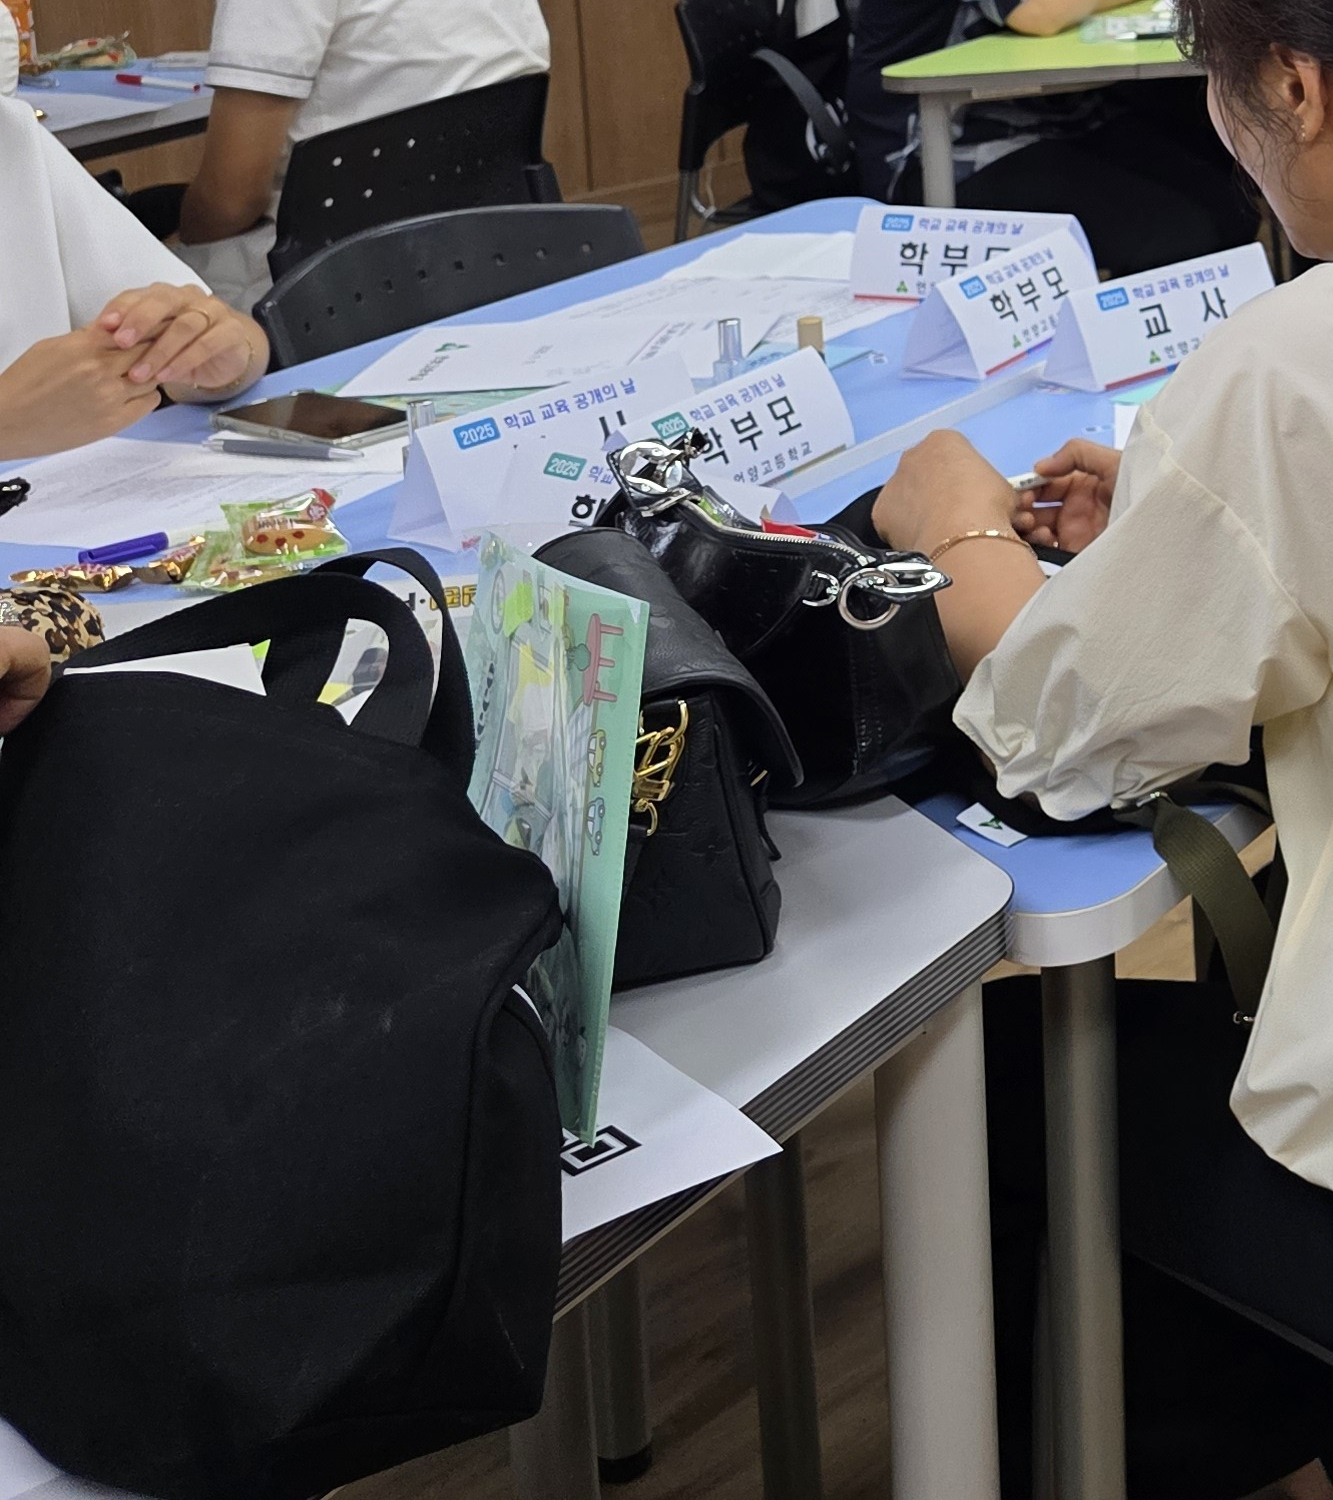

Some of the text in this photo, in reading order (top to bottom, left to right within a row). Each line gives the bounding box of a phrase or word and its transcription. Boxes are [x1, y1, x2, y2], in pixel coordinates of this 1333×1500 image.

[460, 378, 636, 445] 2025 학교 교육 공개의 날
[658, 374, 785, 437] 2025 학교 교육 공개의 날
[549, 458, 581, 477] 2025
